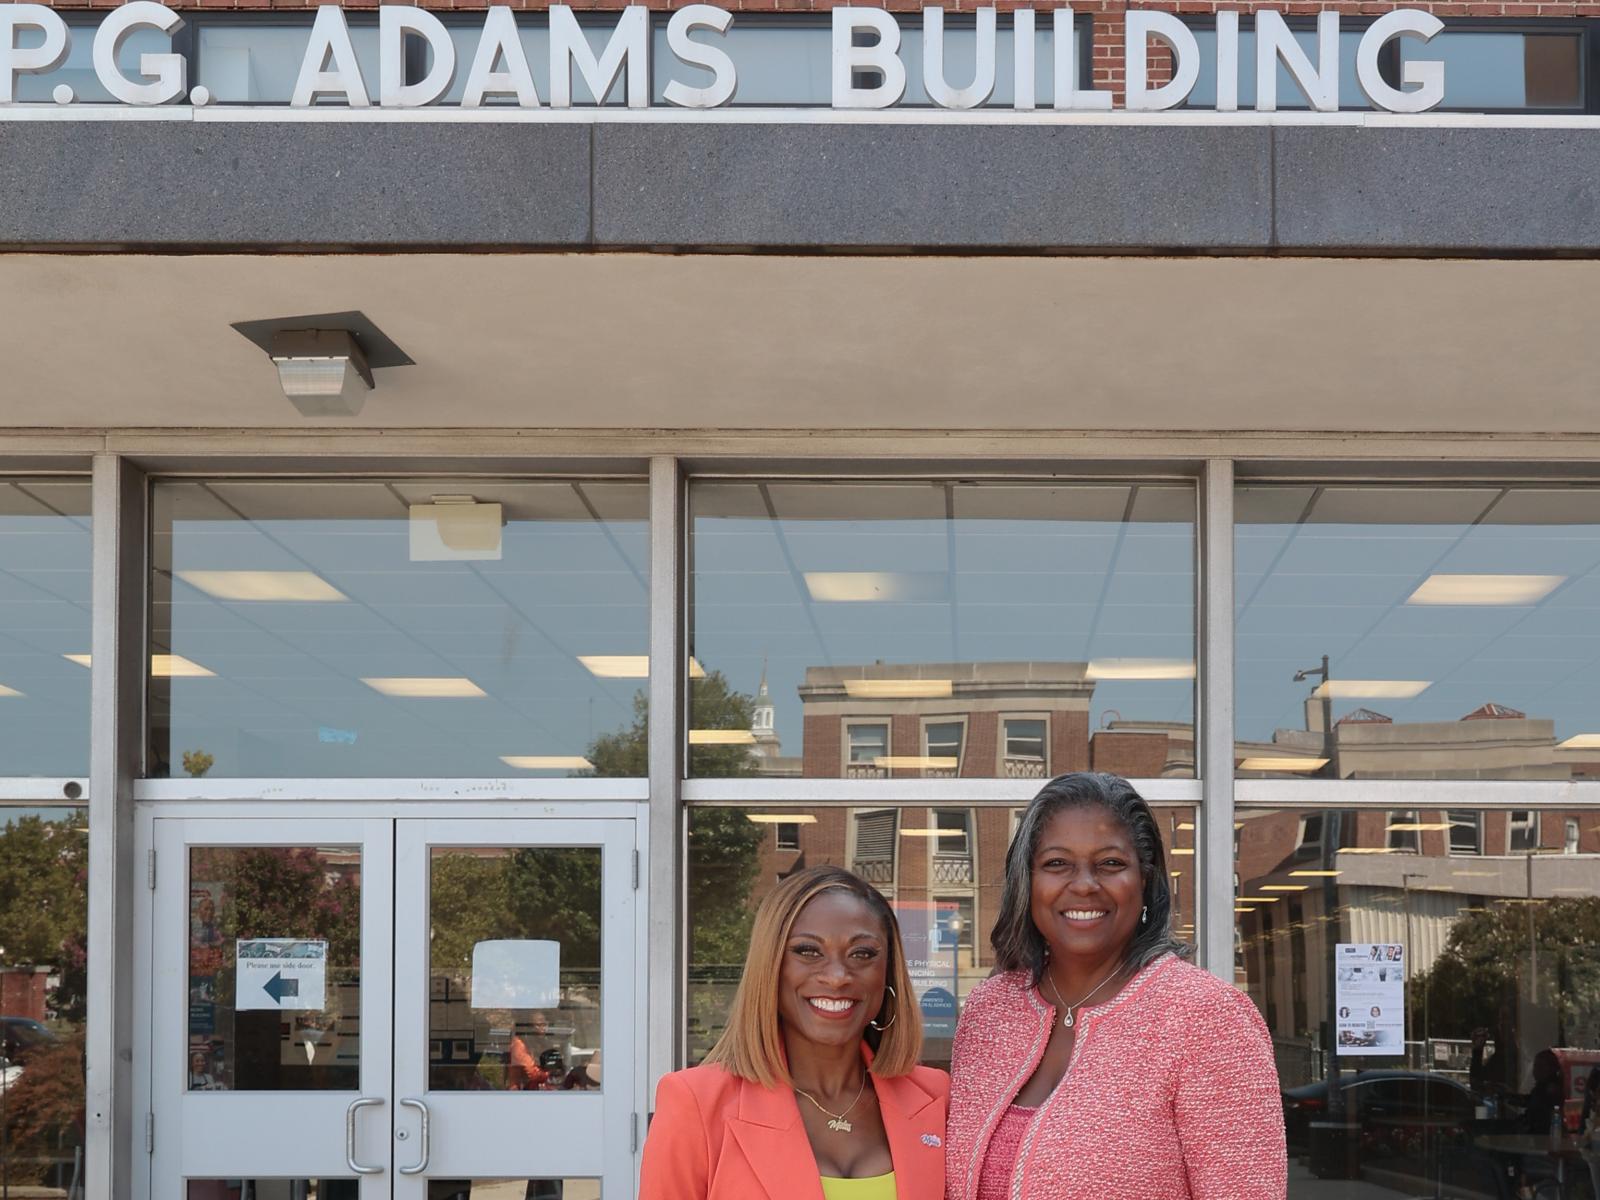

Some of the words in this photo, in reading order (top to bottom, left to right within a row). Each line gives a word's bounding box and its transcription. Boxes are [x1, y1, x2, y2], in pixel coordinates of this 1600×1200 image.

[0, 1, 211, 106] P.G.
[290, 4, 738, 108] ADAMS
[831, 6, 1446, 113] BUILDING
[246, 961, 268, 969] Please
[283, 961, 295, 969] side
